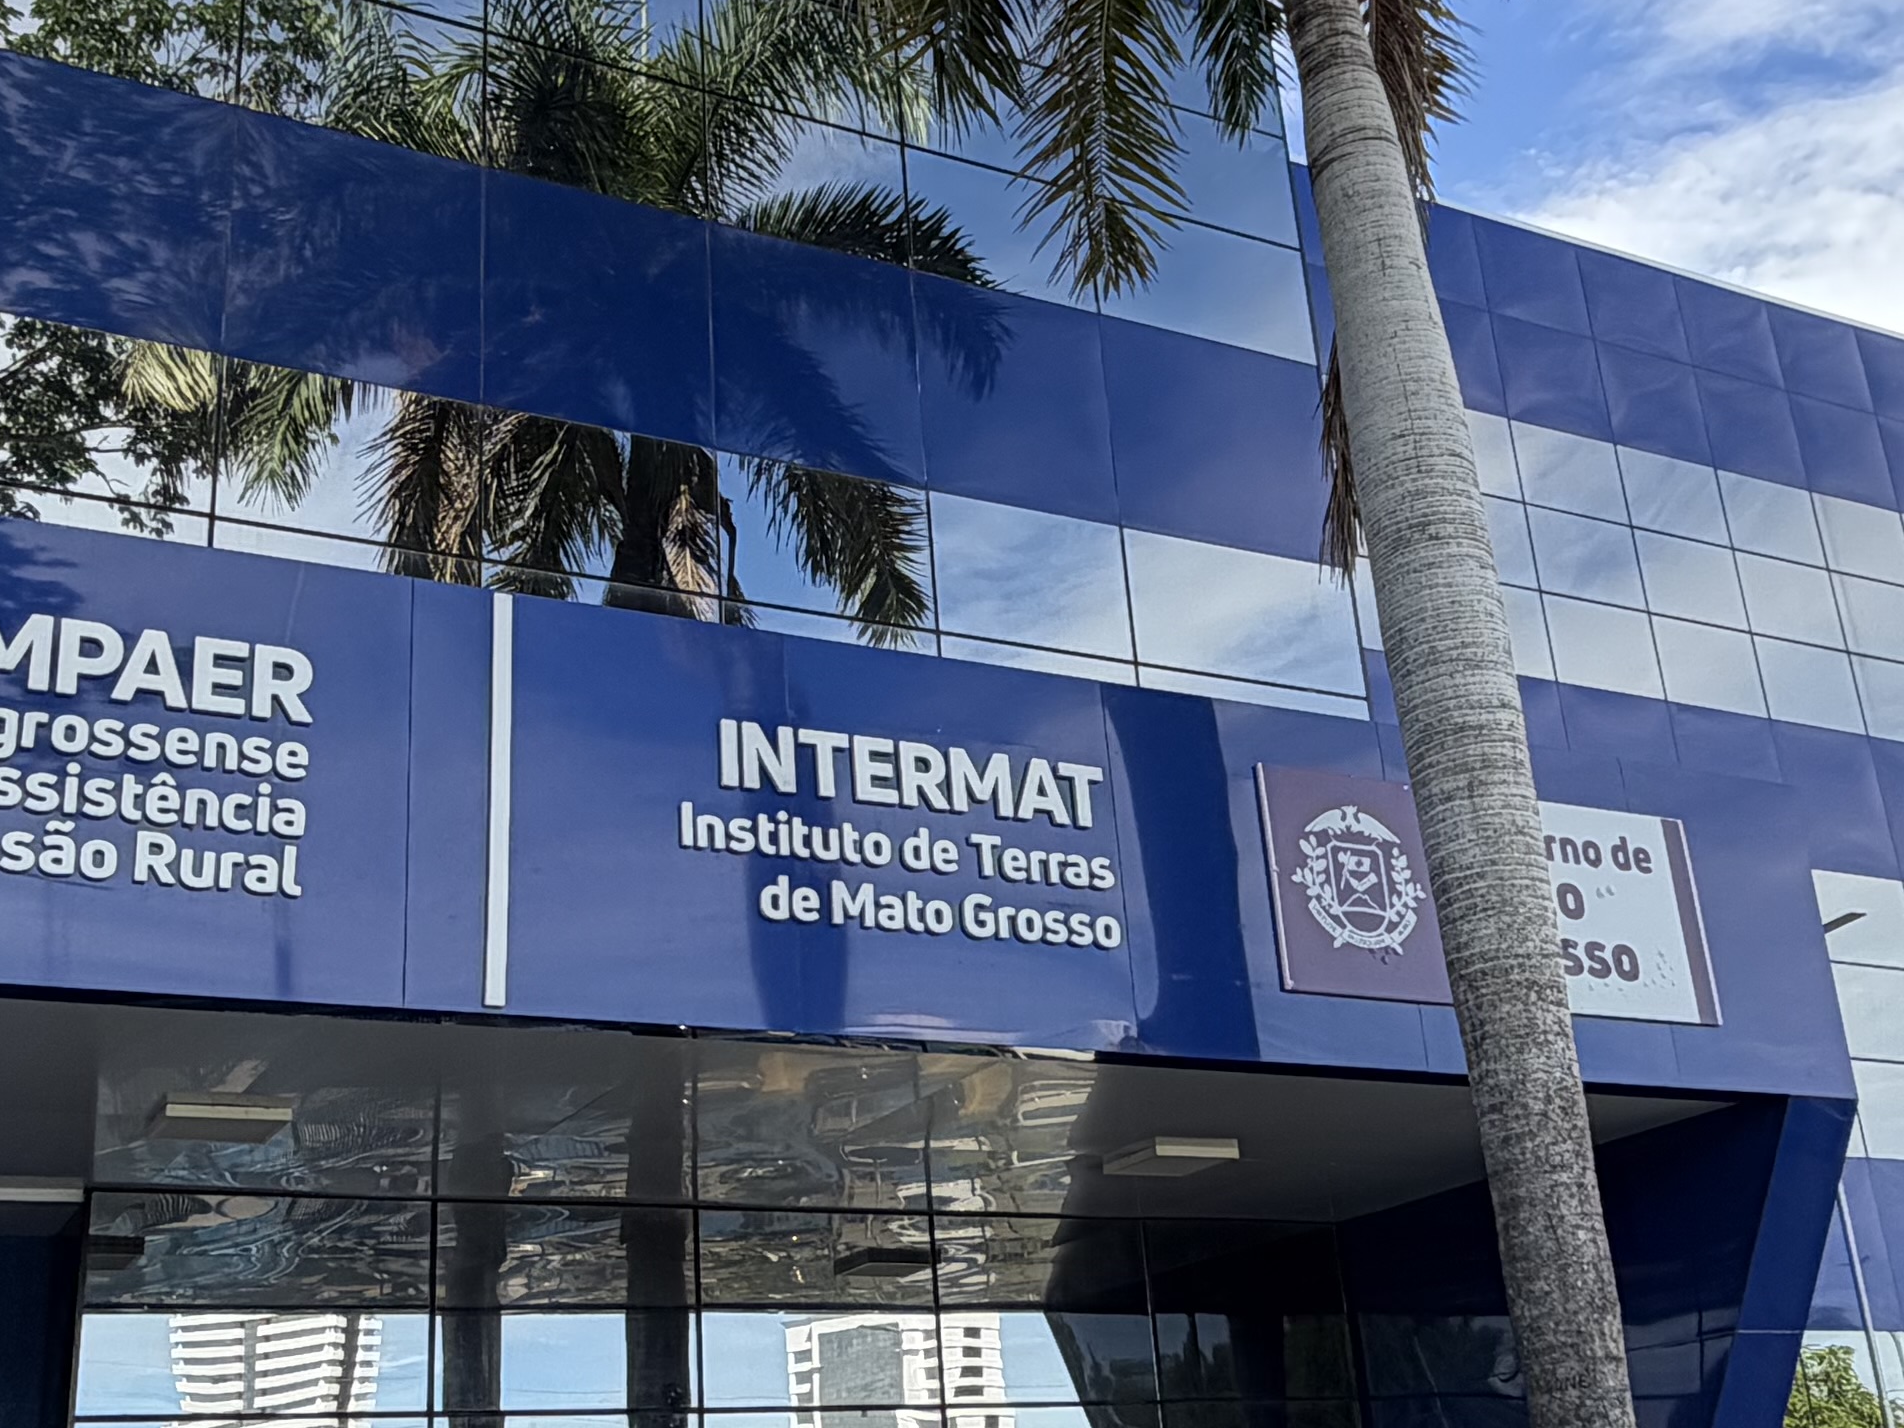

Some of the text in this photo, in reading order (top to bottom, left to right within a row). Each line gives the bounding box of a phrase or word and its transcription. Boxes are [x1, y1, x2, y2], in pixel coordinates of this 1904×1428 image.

[720, 718, 1104, 828] INTERMAT
[134, 830, 303, 897] Rural
[681, 801, 1116, 890] Instituto de Terras
[1611, 836, 1653, 874] de
[760, 875, 1122, 949] de Mato Grosso
[1560, 938, 1640, 982] sso
